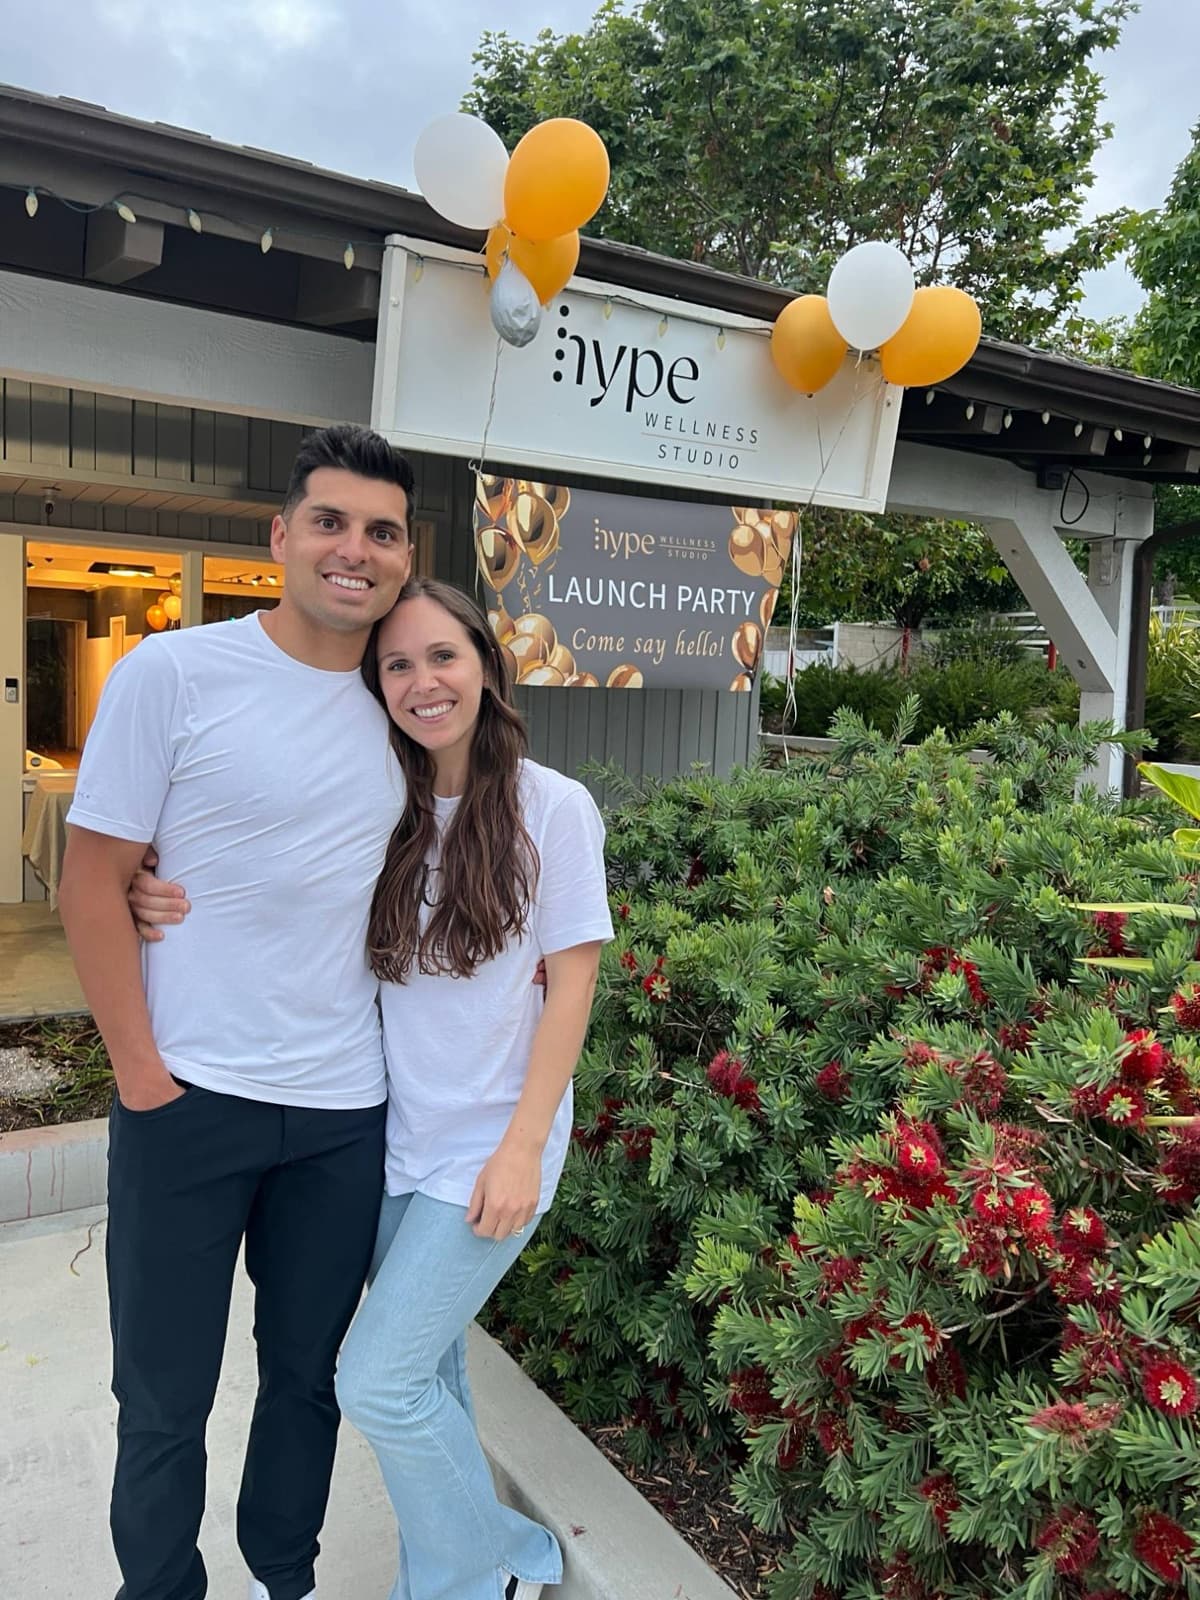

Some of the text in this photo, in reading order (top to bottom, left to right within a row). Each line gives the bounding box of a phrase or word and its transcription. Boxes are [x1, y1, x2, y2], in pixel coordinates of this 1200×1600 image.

[553, 305, 699, 412] hype
[645, 412, 759, 444] WELLNESS
[658, 444, 740, 469] STUDIO
[594, 518, 655, 560] hype
[660, 536, 716, 549] WELLNESS
[667, 549, 708, 560] STUDIO
[549, 575, 756, 616] LAUNCH PARTY
[572, 627, 725, 665] Come say hello!
